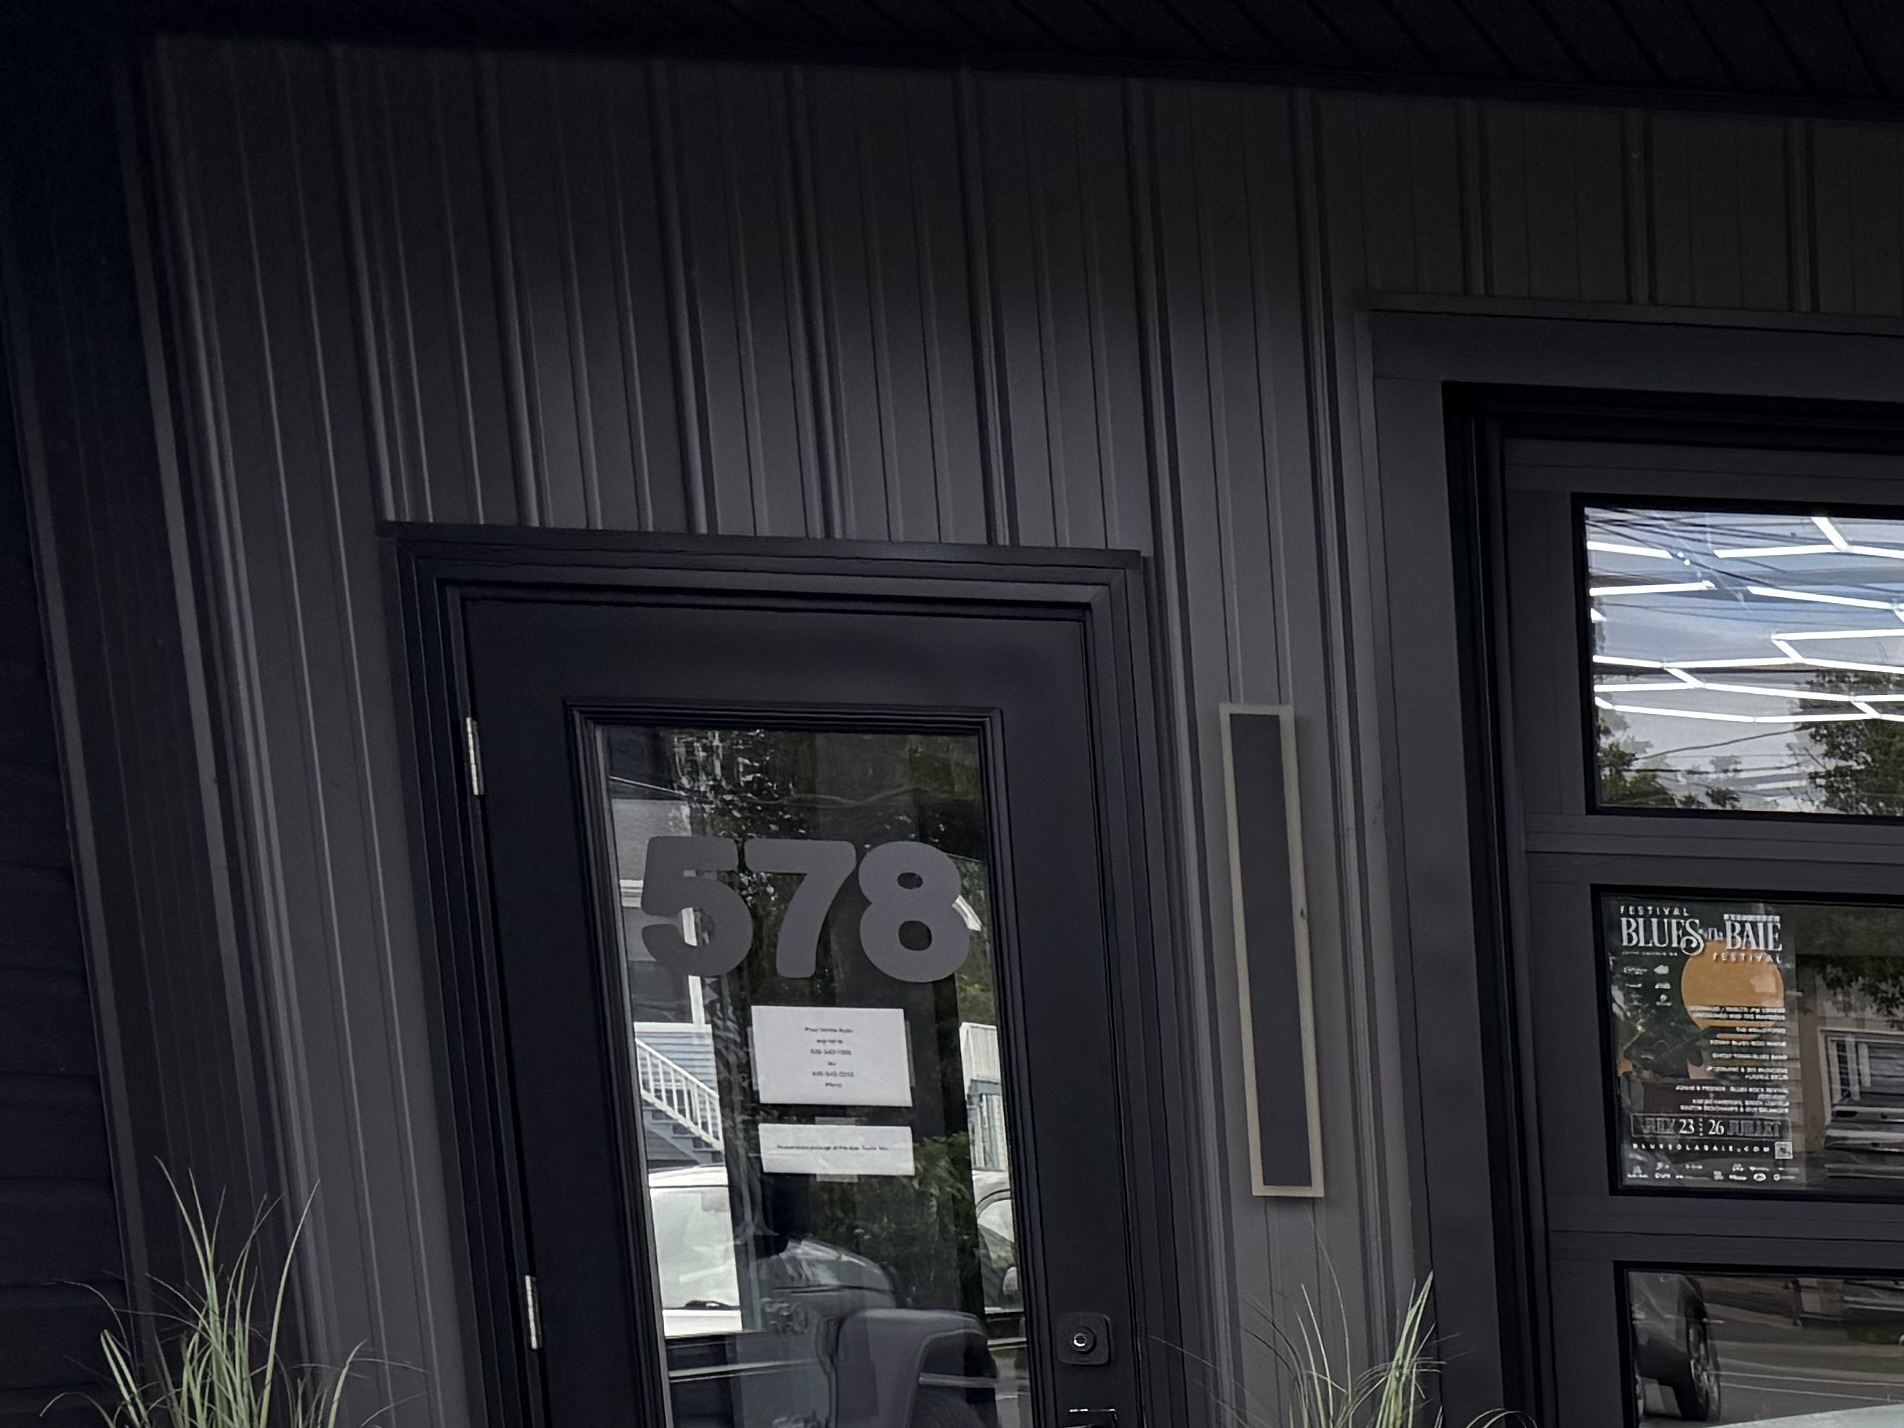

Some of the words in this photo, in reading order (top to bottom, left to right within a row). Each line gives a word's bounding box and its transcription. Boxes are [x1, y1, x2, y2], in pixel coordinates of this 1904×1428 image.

[641, 836, 969, 983] 578
[1620, 905, 1690, 917] FESTIVAL
[1620, 917, 1704, 956] BLUES
[1724, 920, 1783, 952] BAIE
[1712, 952, 1782, 964] FESTIVAL
[1679, 1118, 1695, 1134] 23
[1708, 1119, 1725, 1135] 26
